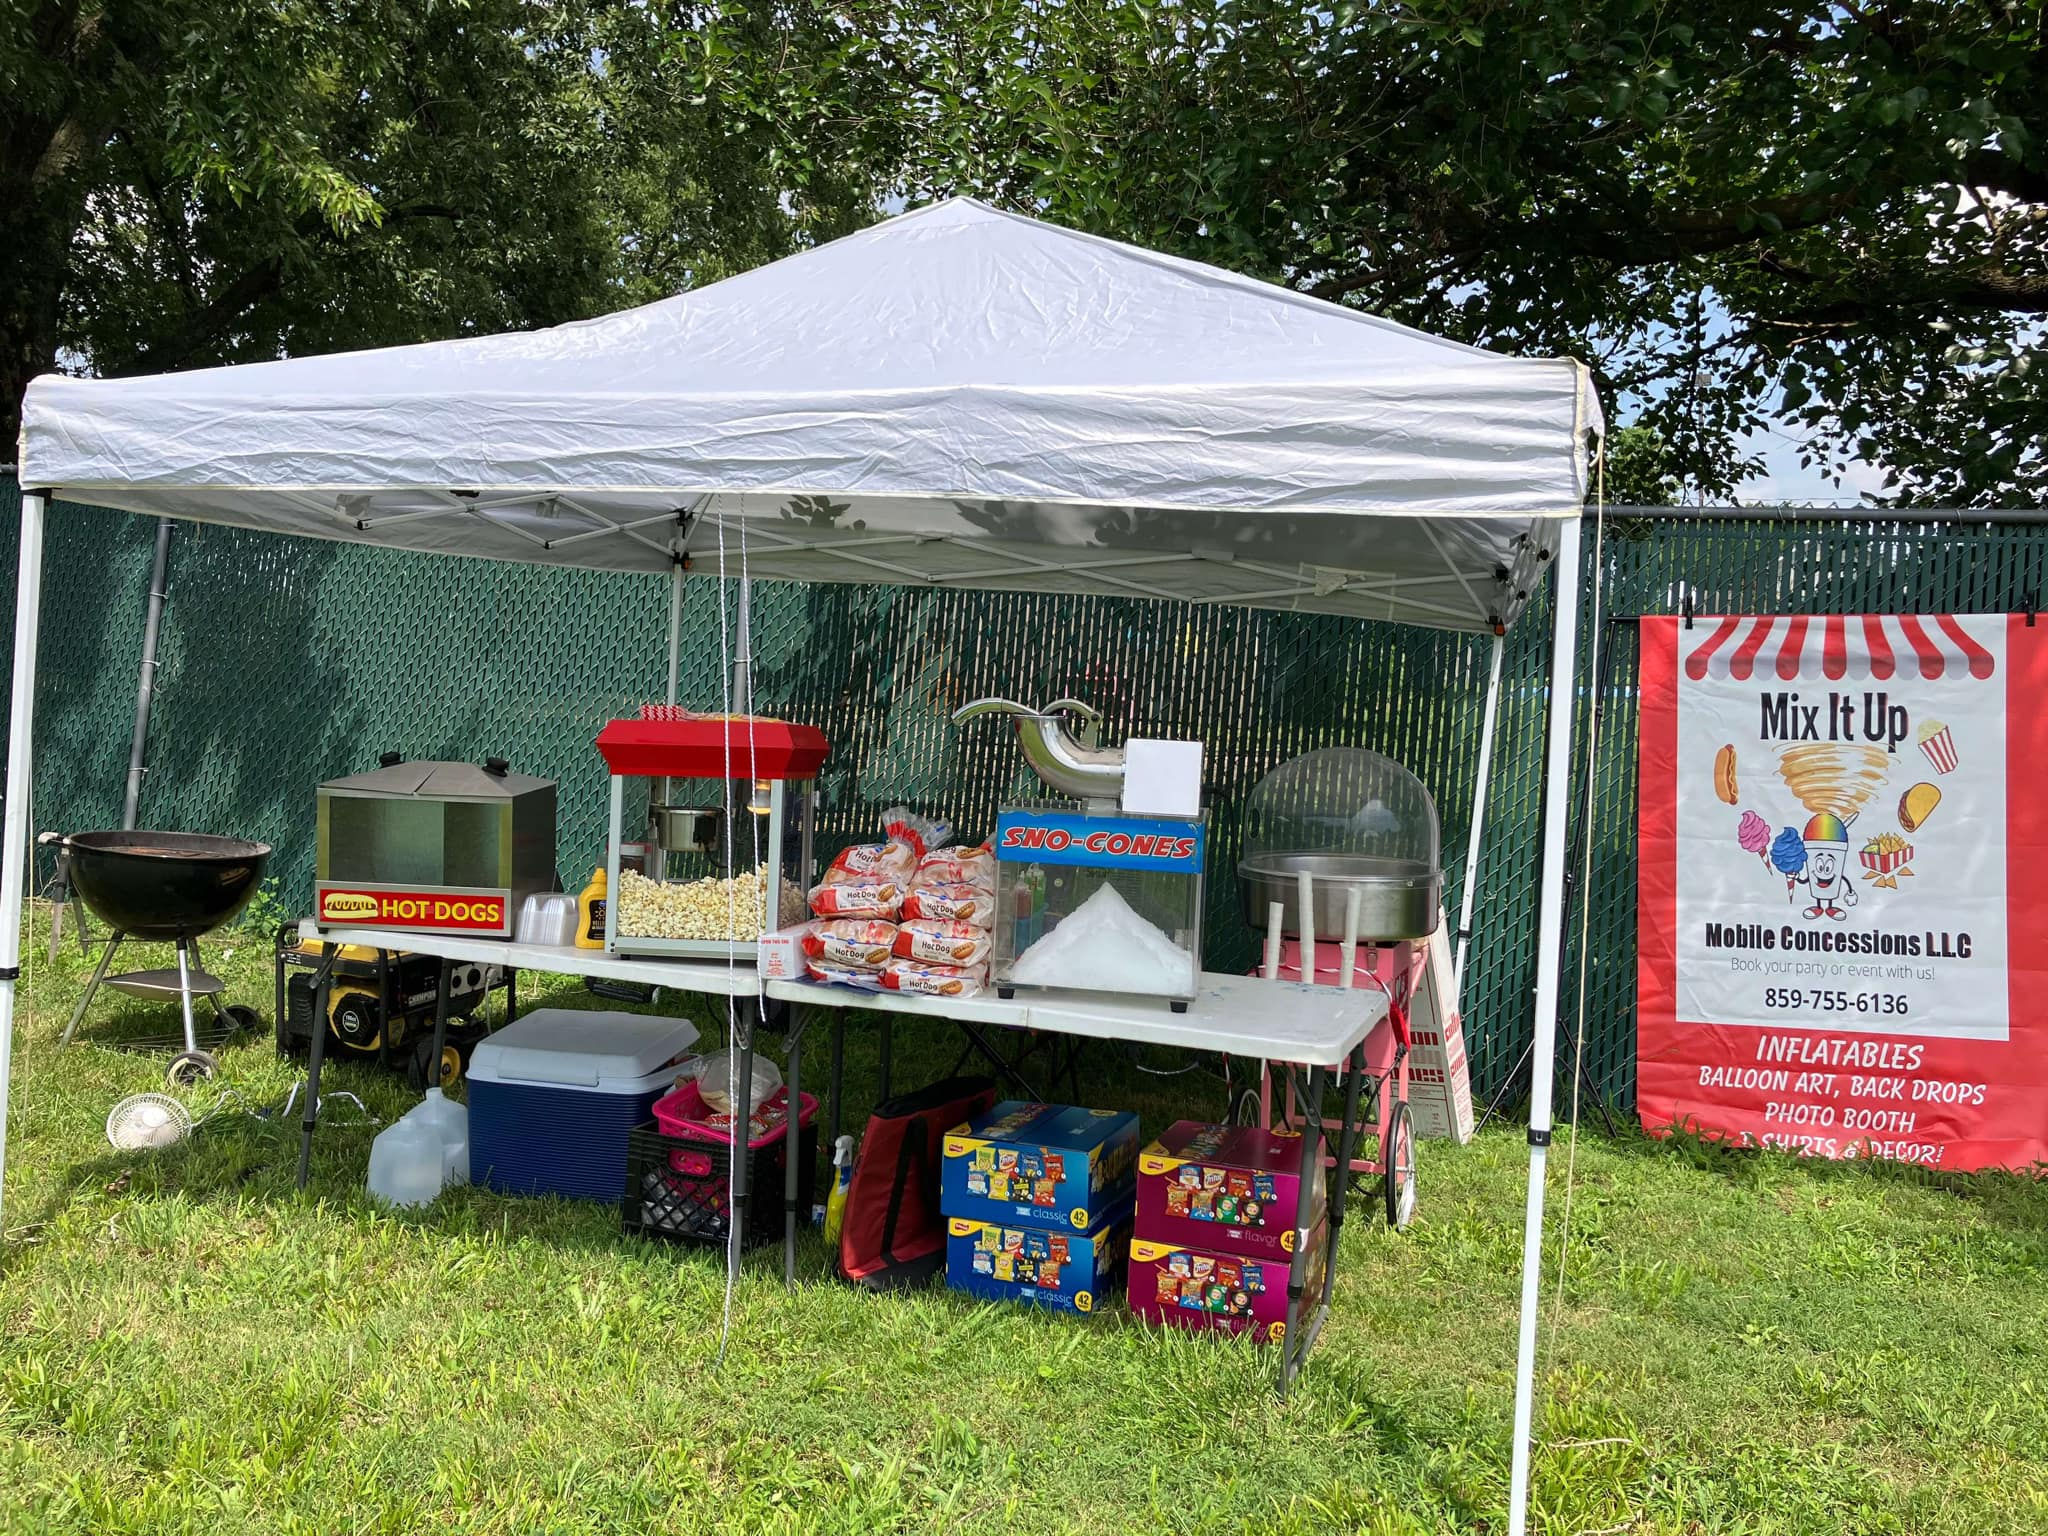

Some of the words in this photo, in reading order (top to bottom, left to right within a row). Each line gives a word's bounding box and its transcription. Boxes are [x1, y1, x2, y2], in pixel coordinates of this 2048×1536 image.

[1760, 692, 1819, 740] Mix
[1829, 692, 1855, 741] It
[1863, 692, 1909, 753] Up
[1002, 827, 1195, 858] SNO-CONES
[382, 899, 430, 919] HOT
[434, 901, 499, 922] DOGS
[922, 941, 935, 950] Hot
[935, 943, 951, 954] Dog
[1706, 923, 1775, 950] Mobile
[1781, 926, 1921, 956] Concessions
[835, 947, 848, 957] Hot
[849, 950, 865, 959] Dog
[1731, 957, 1761, 972] Book
[1764, 961, 1792, 974] your
[1796, 962, 1827, 977] party
[1831, 965, 1845, 975] or
[1848, 965, 1883, 978] event
[1886, 966, 1913, 980] with
[1916, 968, 1935, 980] us!
[909, 980, 923, 988] Hot
[923, 982, 938, 990] Dog
[1765, 988, 1908, 1014] 859-755-6136
[1756, 1035, 1924, 1070] INFLATABLES
[1699, 1065, 1789, 1091] BALLOON
[1794, 1072, 1840, 1098] ART,
[1850, 1075, 1906, 1100] BACK
[1911, 1079, 1987, 1105] DROPS
[1765, 1102, 1835, 1126] PHOTO
[1843, 1108, 1916, 1133] BOOTH
[1871, 1141, 1944, 1163] DECOR!
[1032, 1207, 1068, 1221] classic
[1074, 1211, 1085, 1222] 42
[1244, 1230, 1279, 1244] flavor
[1038, 1289, 1073, 1305] classic
[1079, 1293, 1089, 1305] 42
[1272, 1325, 1285, 1337] 42
